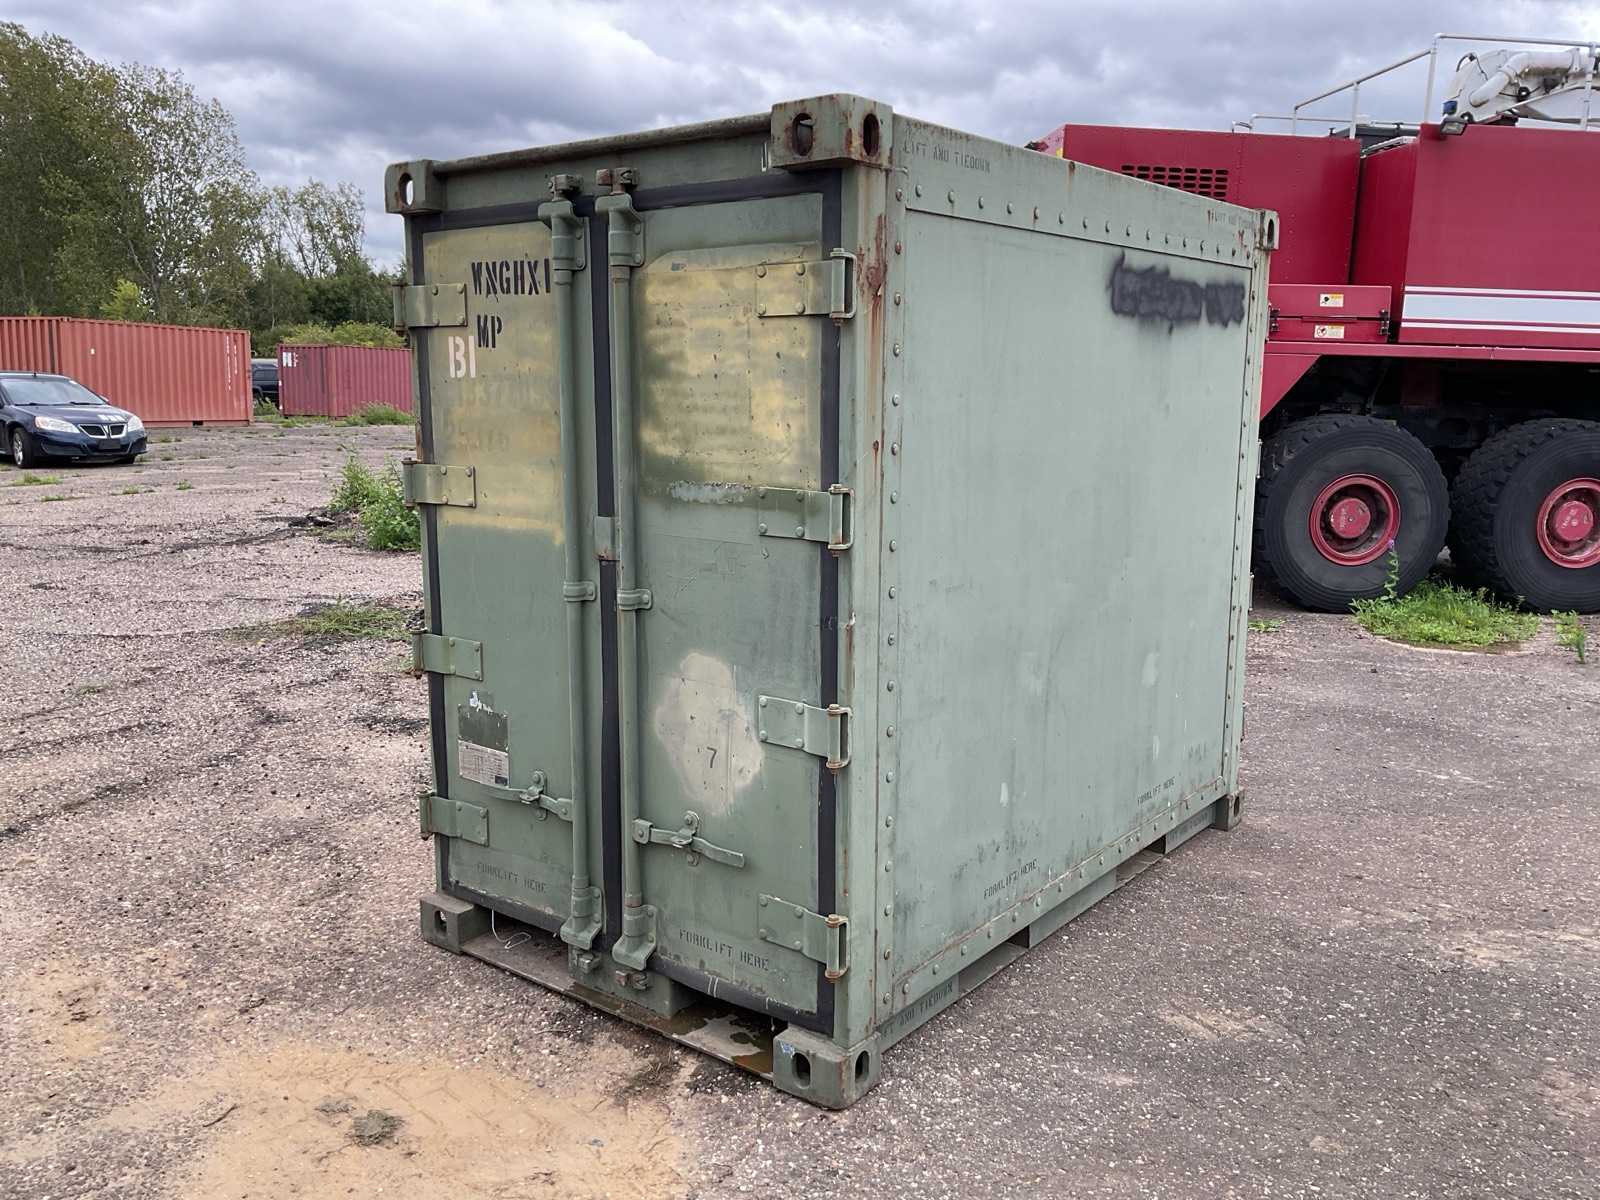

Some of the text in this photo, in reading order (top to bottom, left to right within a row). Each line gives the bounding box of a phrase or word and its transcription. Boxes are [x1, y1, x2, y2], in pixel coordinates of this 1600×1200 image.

[476, 314, 503, 349] MP
[1020, 857, 1038, 876] HERE
[679, 928, 770, 972] FORKLIFT HERE
